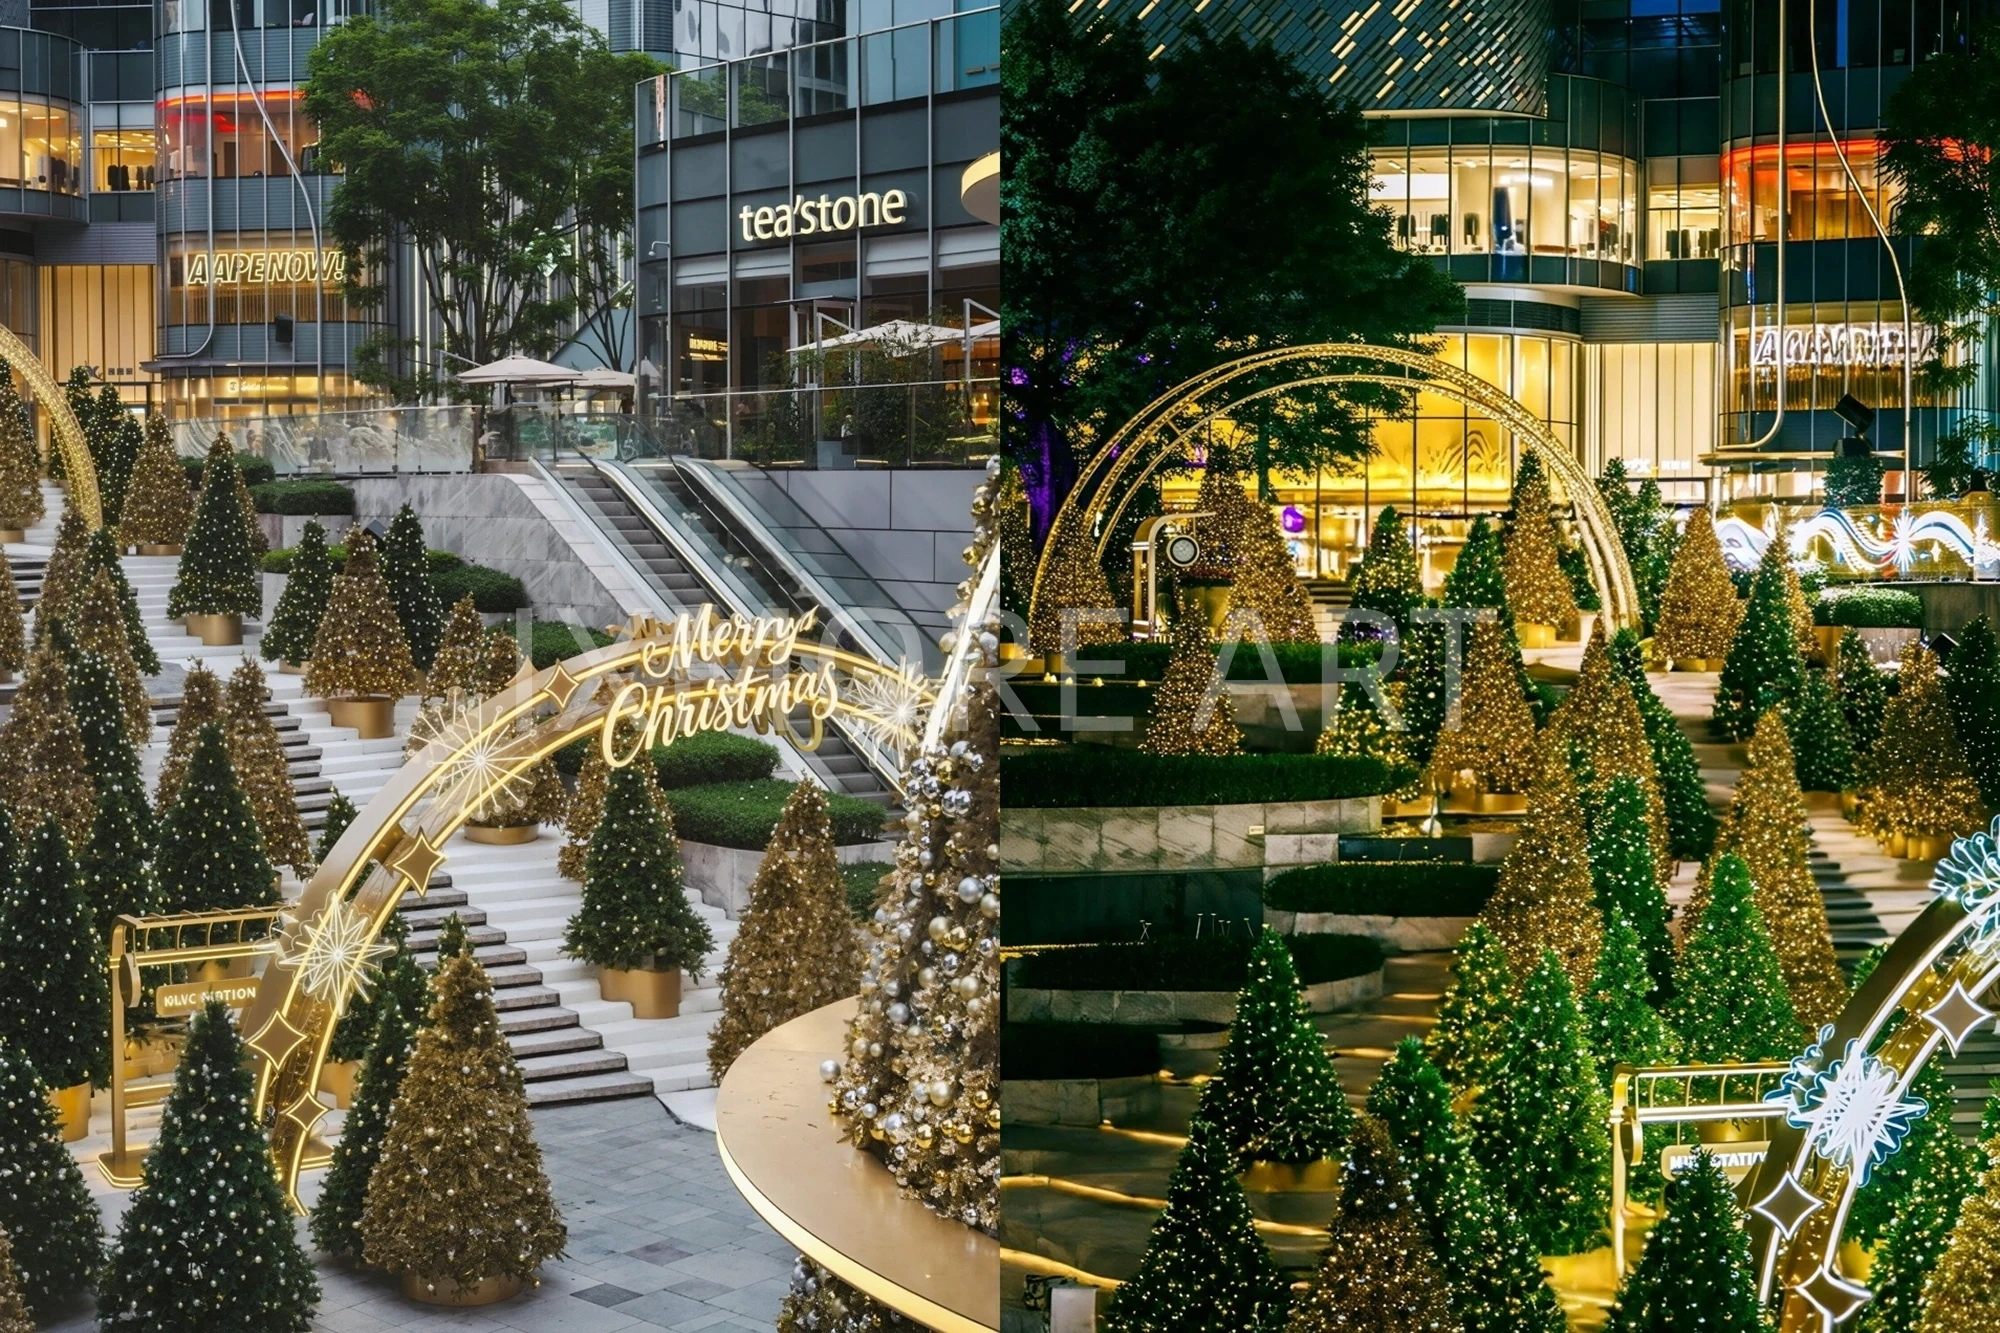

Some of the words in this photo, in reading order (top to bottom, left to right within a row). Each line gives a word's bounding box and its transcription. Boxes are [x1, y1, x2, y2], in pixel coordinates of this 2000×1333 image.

[739, 189, 908, 242] tea'stone
[642, 602, 820, 678] Merry
[602, 660, 839, 768] Christmas
